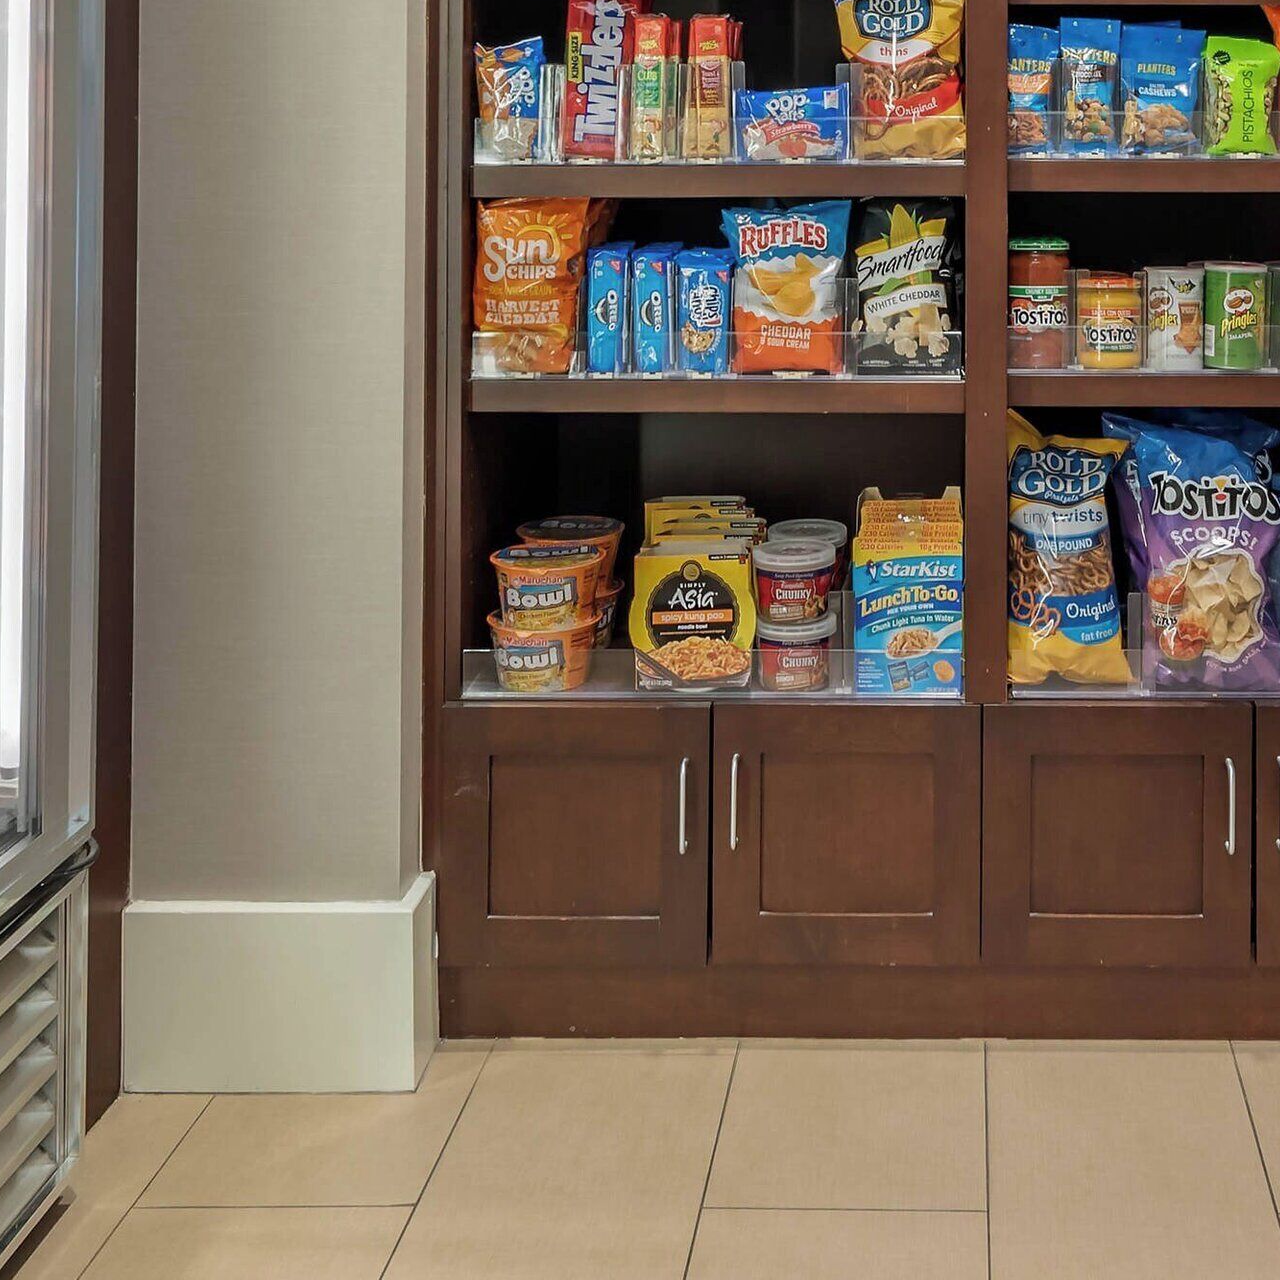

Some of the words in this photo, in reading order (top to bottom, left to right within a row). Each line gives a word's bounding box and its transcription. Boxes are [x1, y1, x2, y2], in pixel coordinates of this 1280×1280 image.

[862, 10, 925, 34] GOLD
[1137, 62, 1176, 76] PLANTERS
[1138, 86, 1177, 98] CASHEWS
[894, 97, 938, 118] Original
[1242, 70, 1255, 143] PISTACHIOS
[771, 123, 813, 139] Strawberry
[740, 219, 828, 258] RUFFLES
[483, 234, 561, 283] Sun
[857, 238, 947, 286] Smartfood
[507, 264, 557, 280] CHIPS
[484, 298, 561, 314] HARVEST
[867, 296, 898, 315] WHITE
[898, 289, 941, 303] CHEDDAR
[484, 310, 560, 326] CHEDDAR
[1012, 304, 1067, 326] TOSTITOS
[1221, 308, 1259, 338] Pringles
[761, 324, 811, 340] CHEDDAR
[1085, 326, 1137, 344] TOSTITOS
[767, 338, 786, 348] SOUR
[786, 339, 810, 350] CREAM
[1030, 450, 1105, 474] ROLD
[1018, 469, 1108, 496] GOLD
[1044, 490, 1082, 503] Pretzels
[1023, 511, 1048, 527] tiny
[1035, 539, 1057, 551] ONE
[1057, 538, 1093, 551] POUND
[1170, 524, 1259, 551] SCOOPS!
[932, 543, 959, 551] Protein
[880, 560, 958, 578] StarKist
[518, 574, 564, 586] Maruchan
[506, 586, 573, 609] Bowl
[667, 587, 718, 611] Asia
[775, 587, 812, 600] CHUNKY
[859, 588, 910, 618] Lunch
[1065, 596, 1116, 620] Original
[661, 612, 683, 624] spicy
[683, 612, 706, 625] kung
[871, 622, 891, 634] Chunk
[892, 619, 909, 629] Light
[909, 617, 926, 626] Tuna
[933, 614, 955, 623] Water
[1080, 630, 1093, 642] fat
[1094, 628, 1113, 640] free
[496, 646, 559, 670] Bowl
[782, 655, 819, 668] CHUNKY
